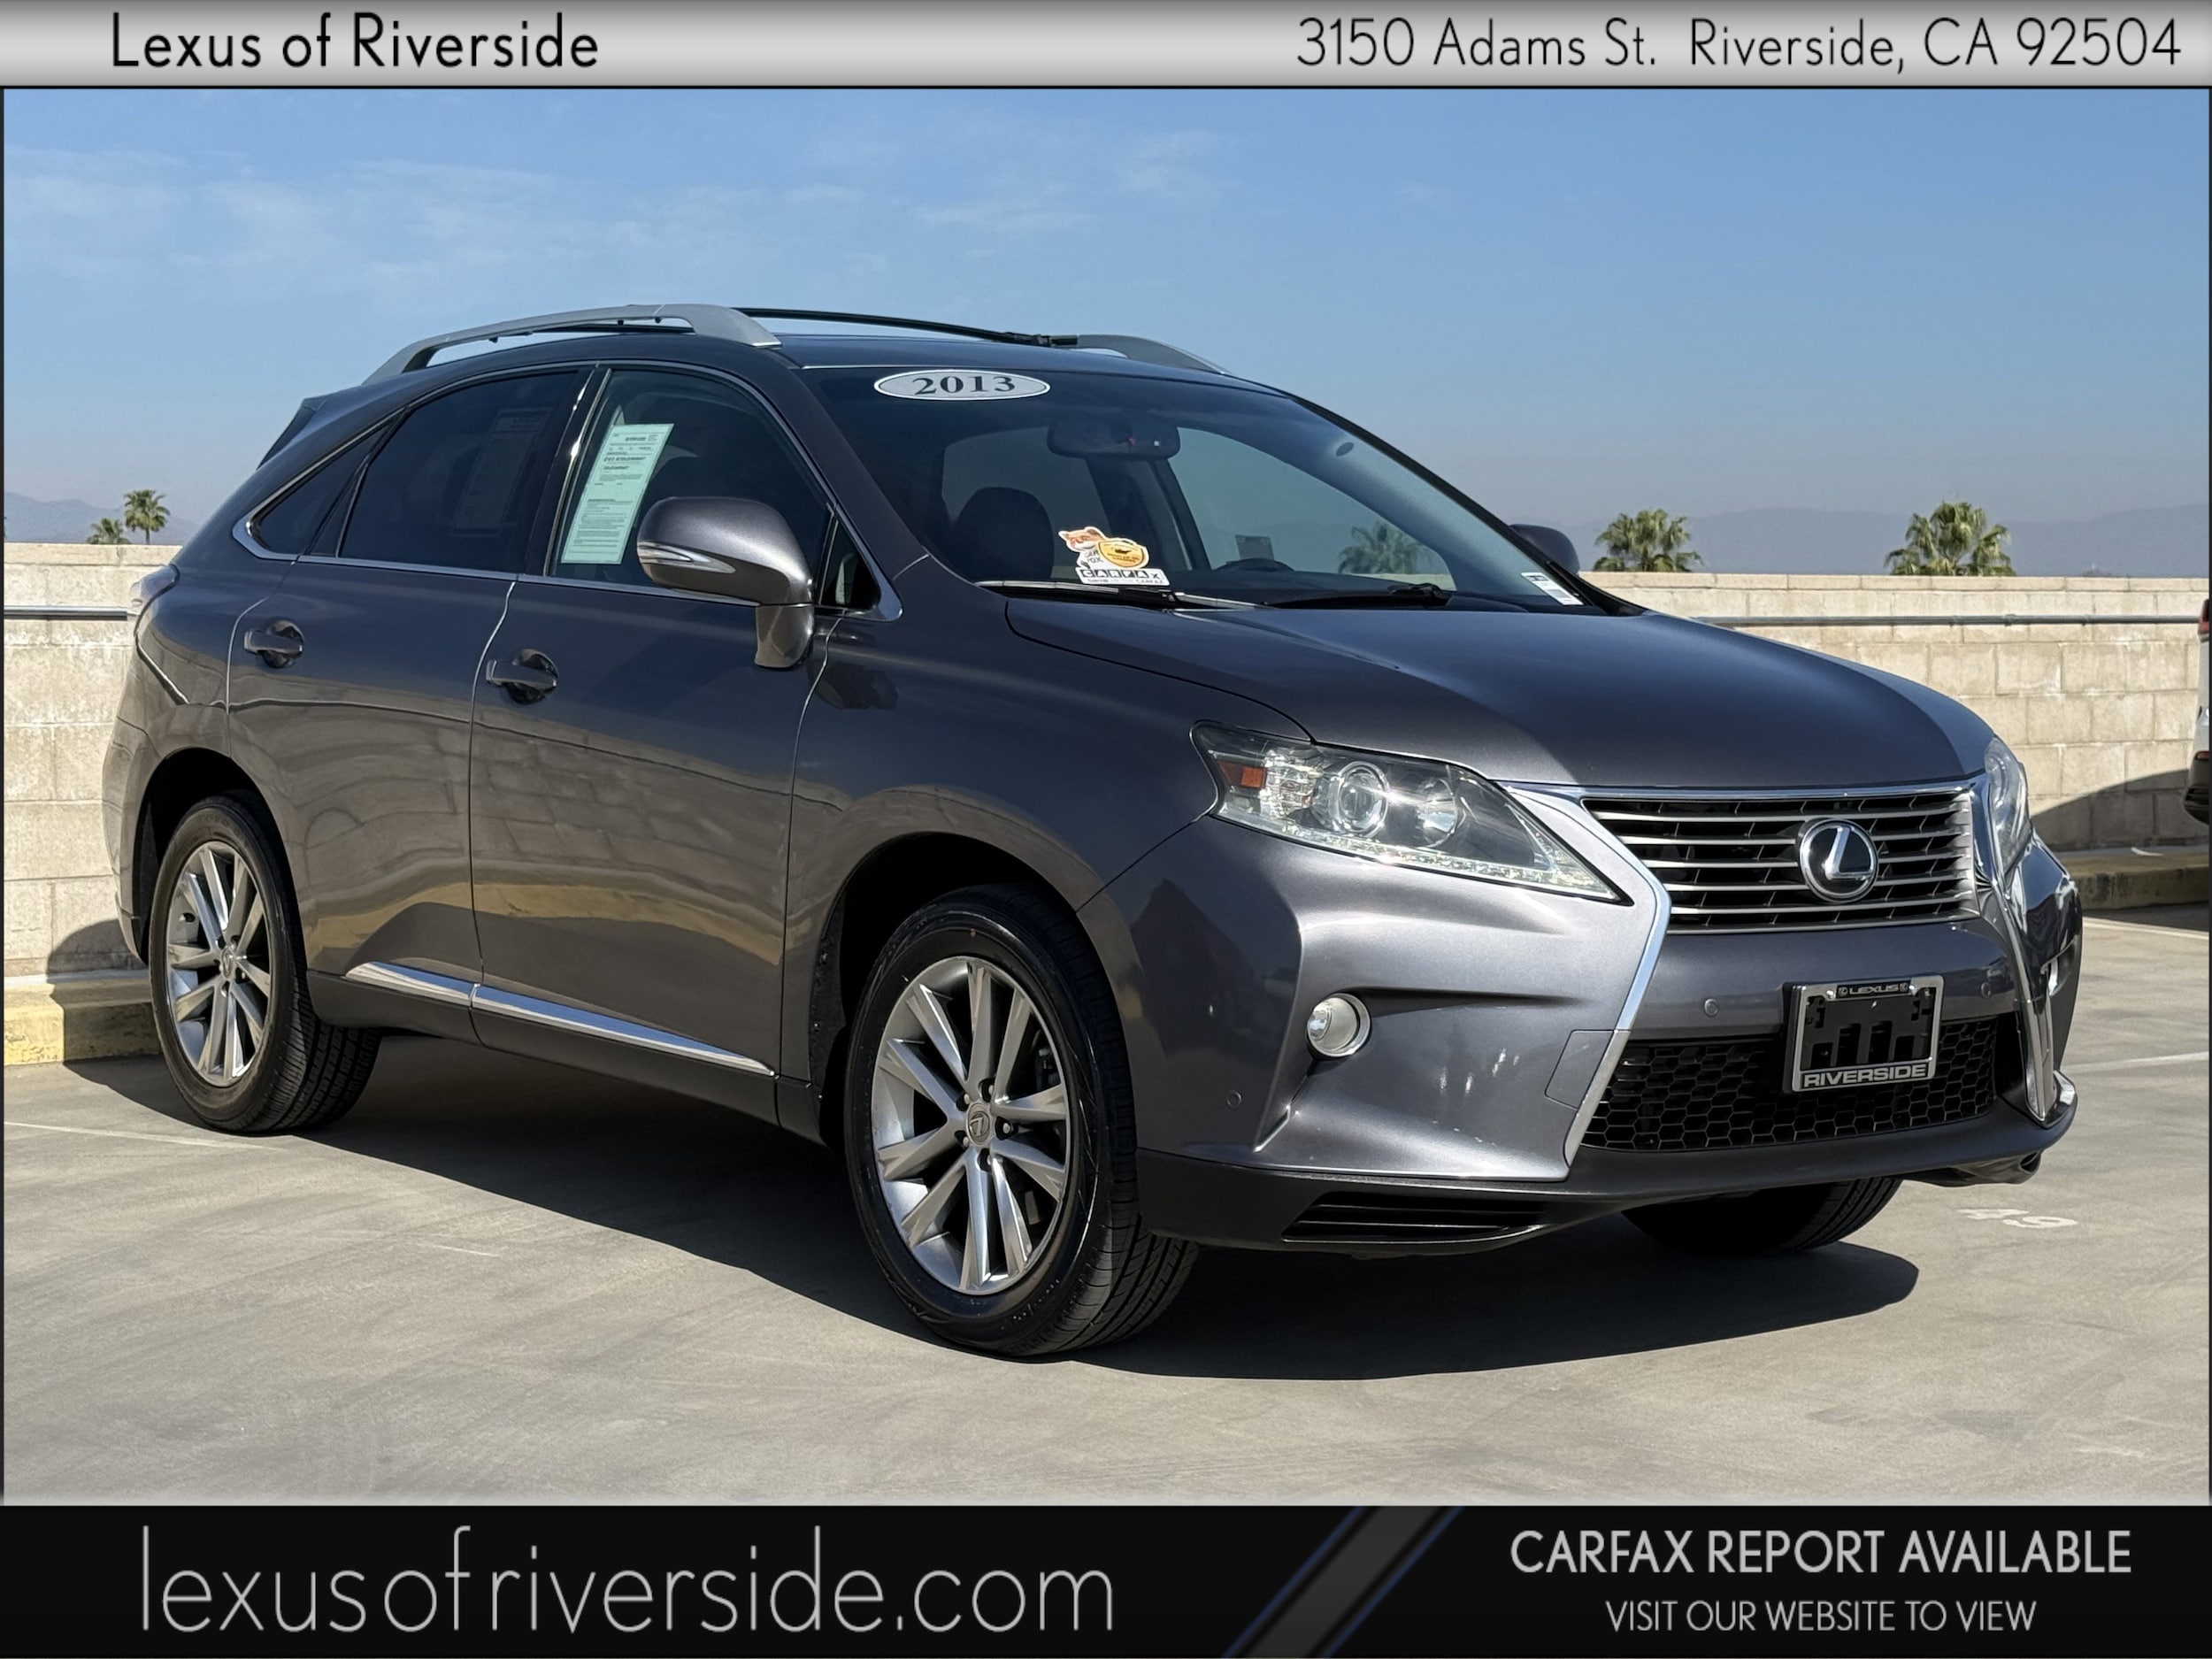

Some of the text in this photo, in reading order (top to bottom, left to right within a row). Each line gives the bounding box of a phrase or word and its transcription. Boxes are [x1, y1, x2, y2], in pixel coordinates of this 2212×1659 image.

[912, 375, 1016, 396] 2013
[1079, 569, 1161, 579] CARFAX
[1849, 983, 1900, 995] LEXUS
[1803, 1064, 1927, 1088] RIVERSIDE
